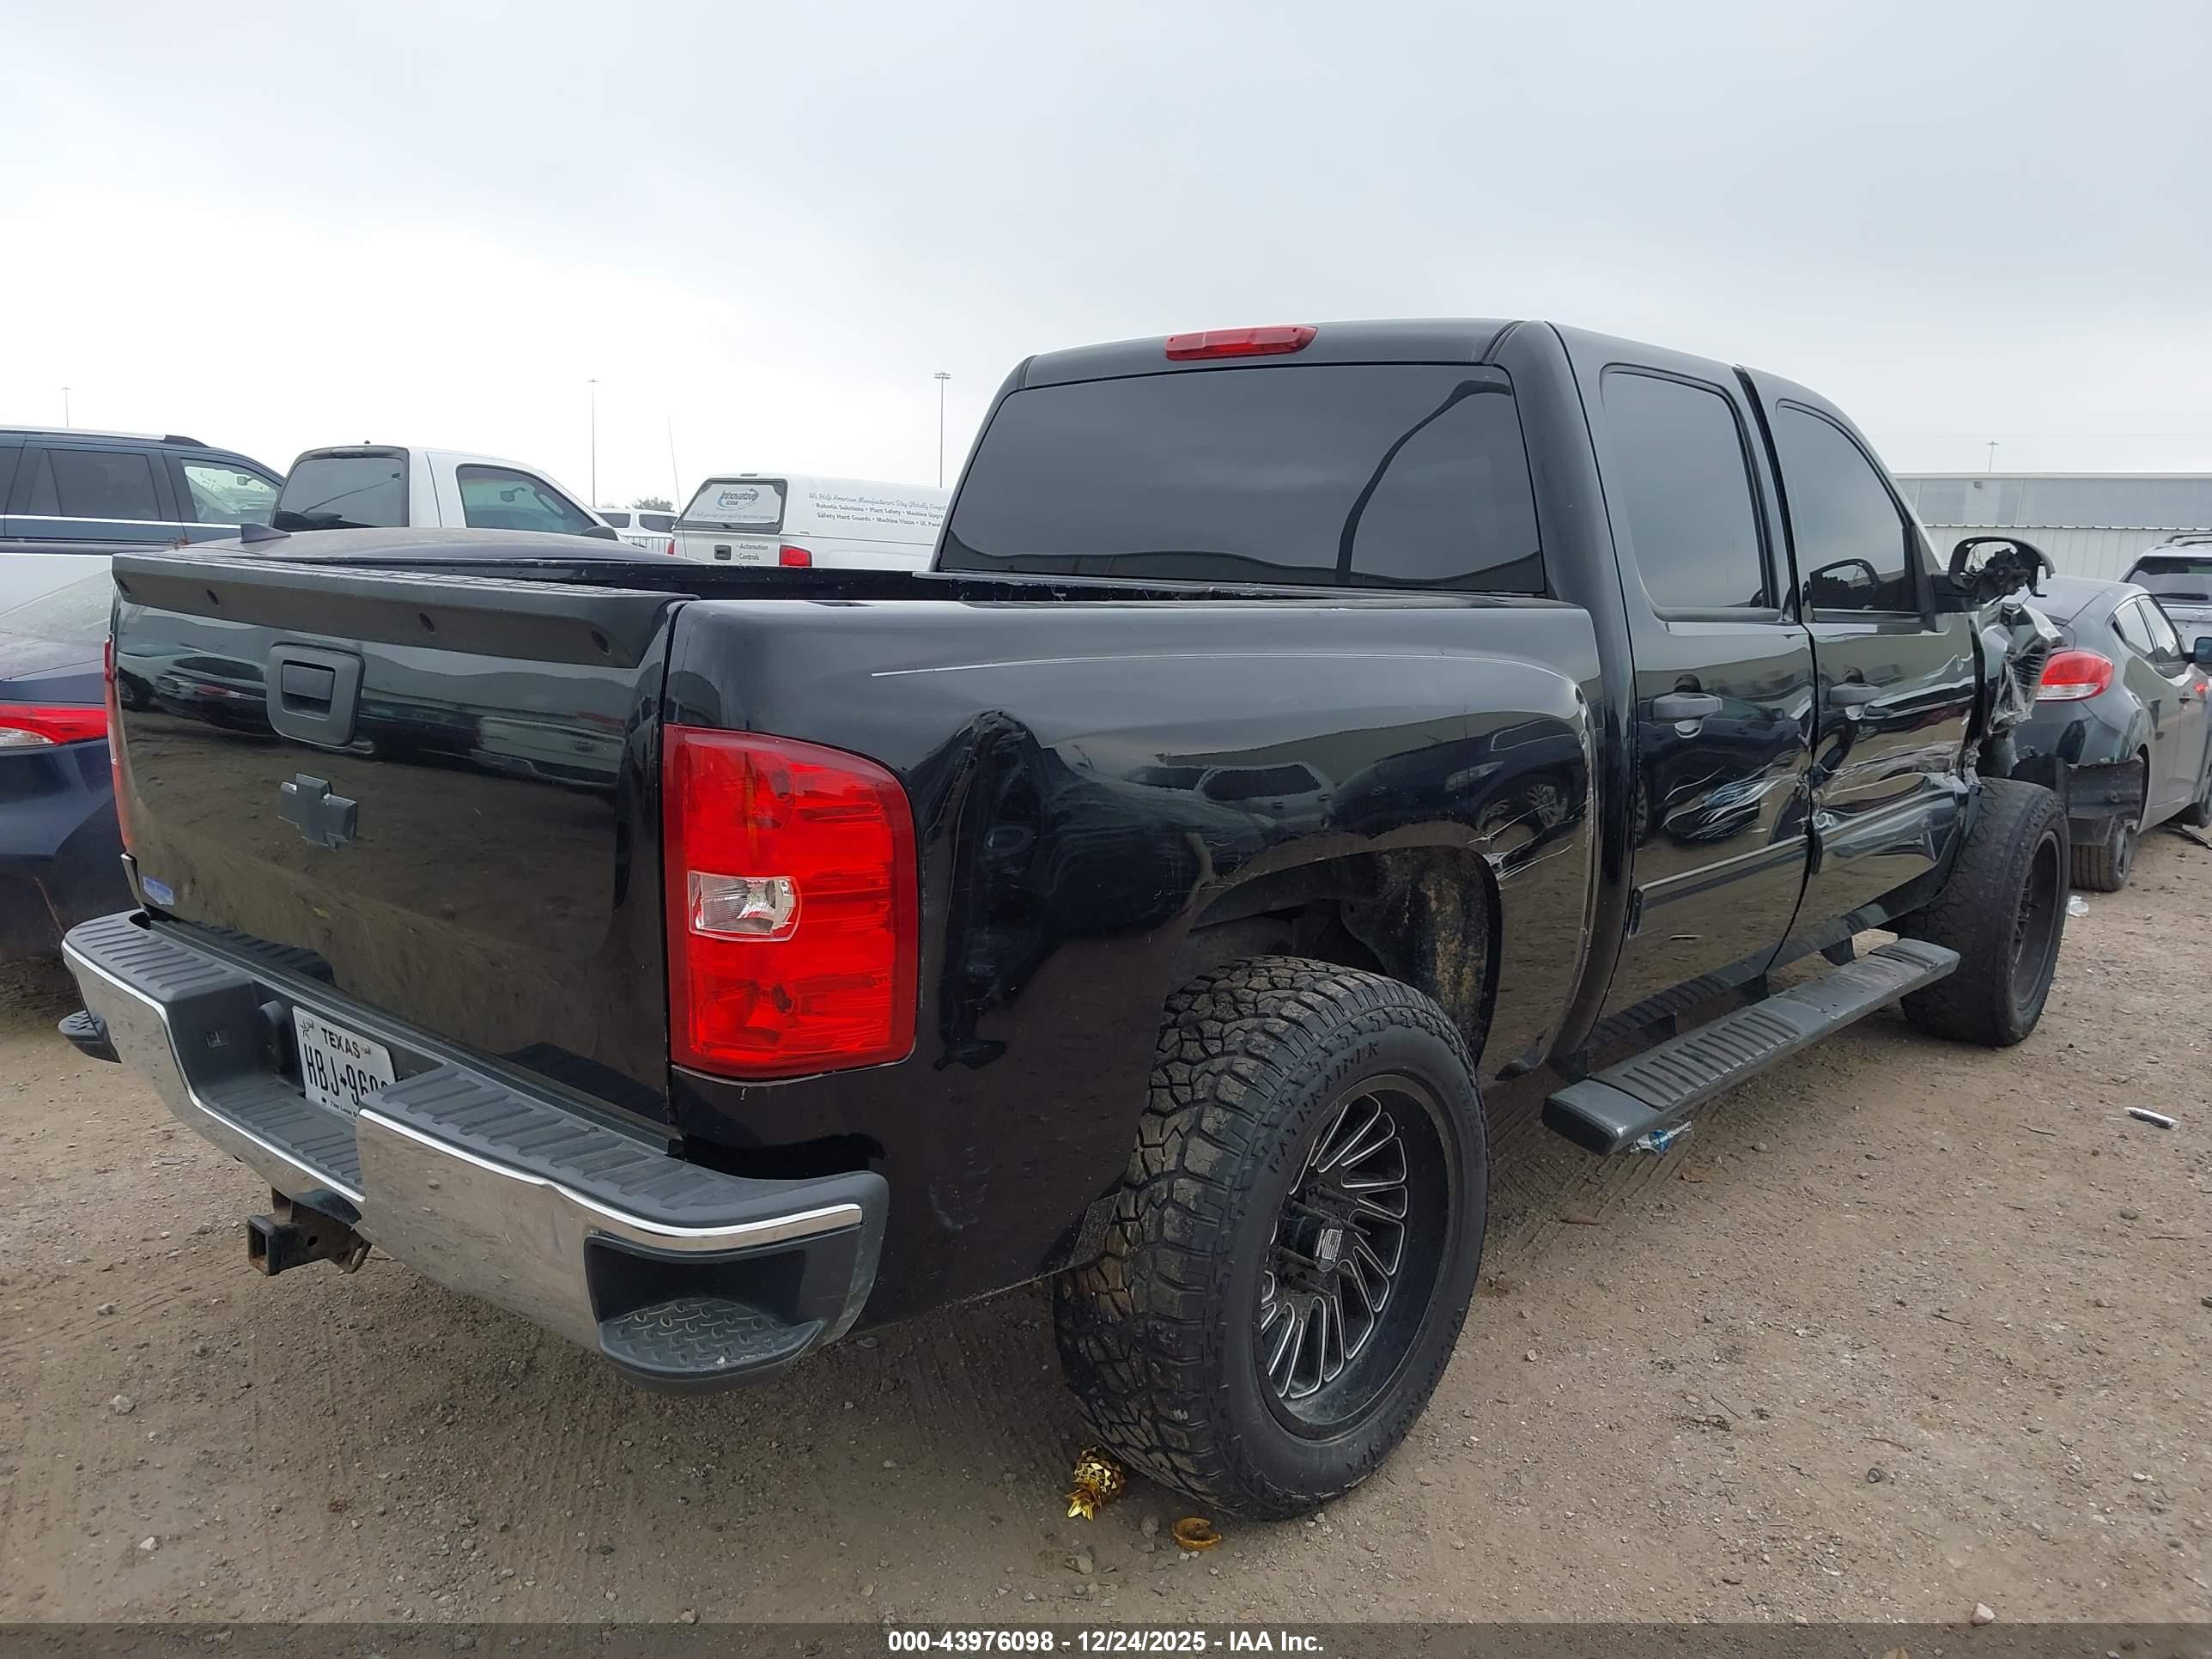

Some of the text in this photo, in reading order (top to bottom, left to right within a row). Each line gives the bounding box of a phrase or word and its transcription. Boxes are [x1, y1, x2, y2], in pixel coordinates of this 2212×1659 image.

[817, 512, 835, 520] Safety
[884, 507, 901, 516] Safety
[320, 1027, 361, 1059] TEXAS
